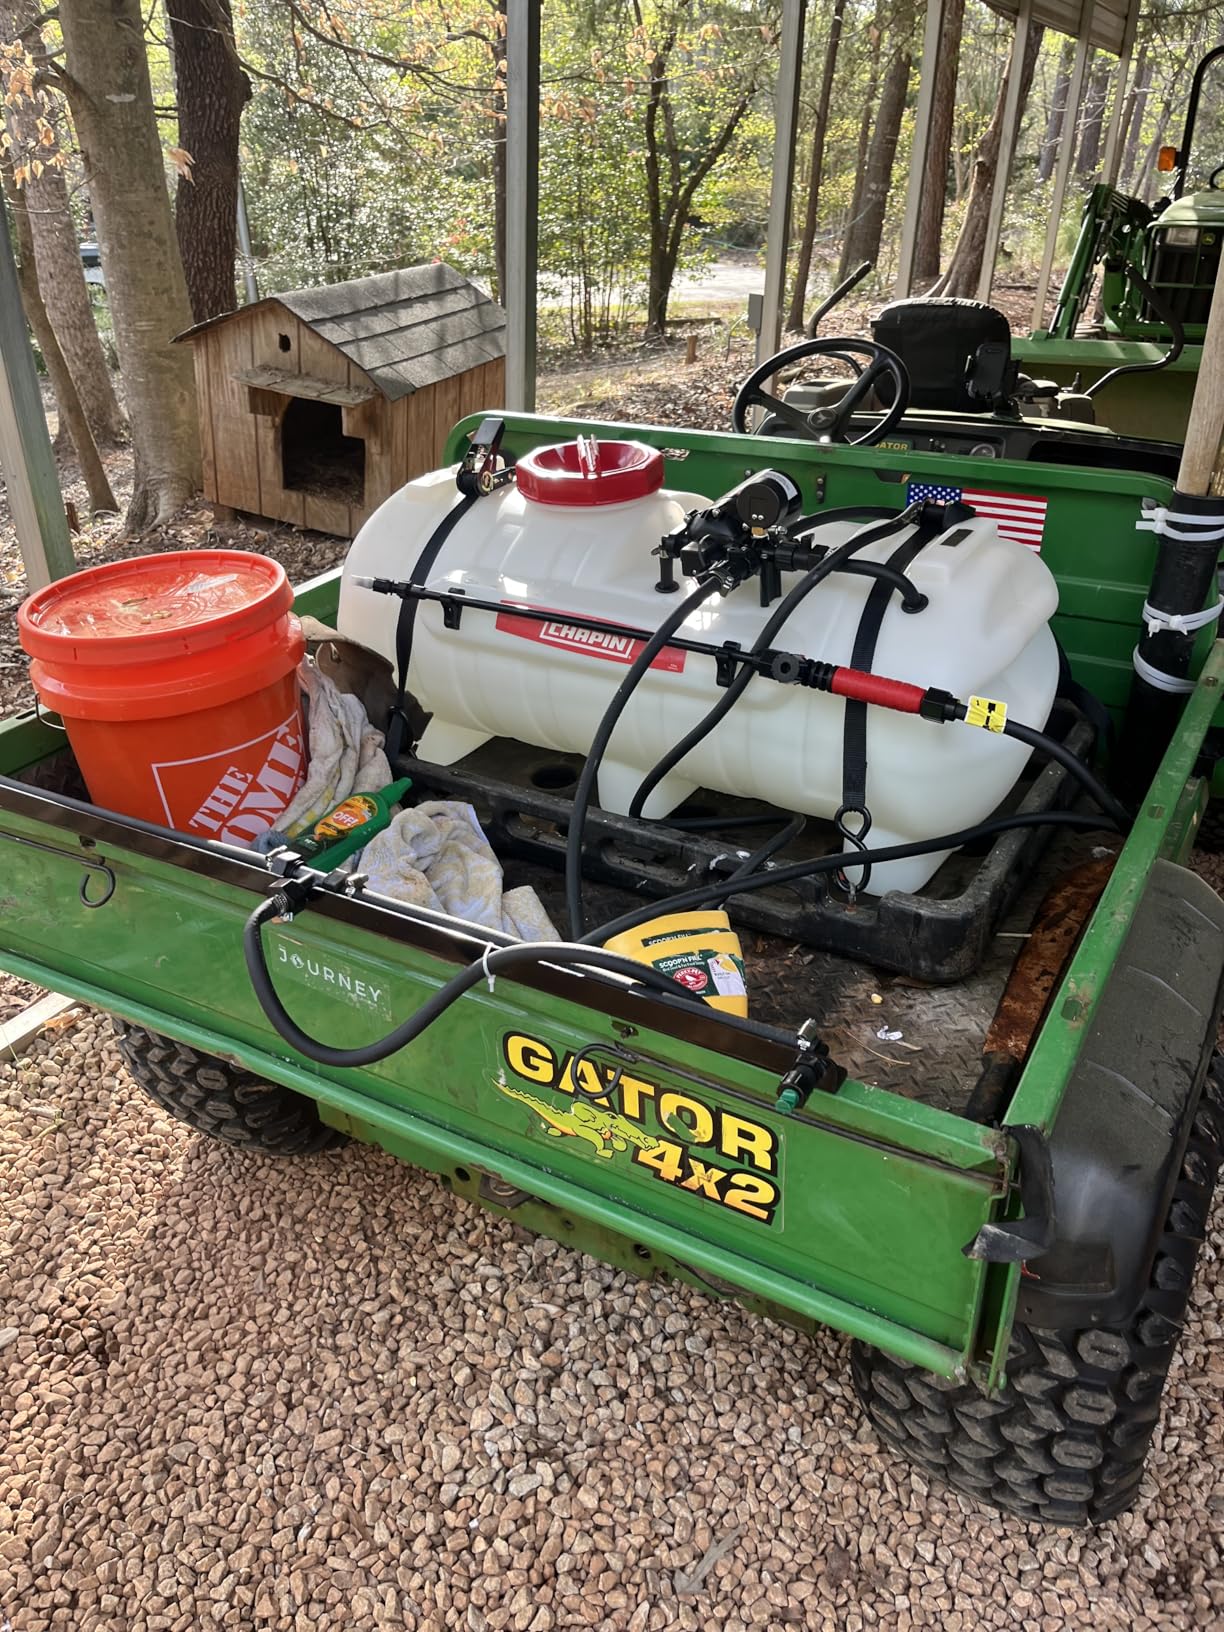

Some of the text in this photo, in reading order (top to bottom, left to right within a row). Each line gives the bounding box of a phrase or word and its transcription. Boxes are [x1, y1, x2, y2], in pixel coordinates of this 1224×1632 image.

[548, 622, 628, 651] CHAPIN
[188, 765, 254, 832] THE
[220, 725, 301, 848] OME
[332, 811, 359, 827] OFF!
[278, 944, 381, 1002] JOURNEY
[504, 1032, 776, 1174] GATOR
